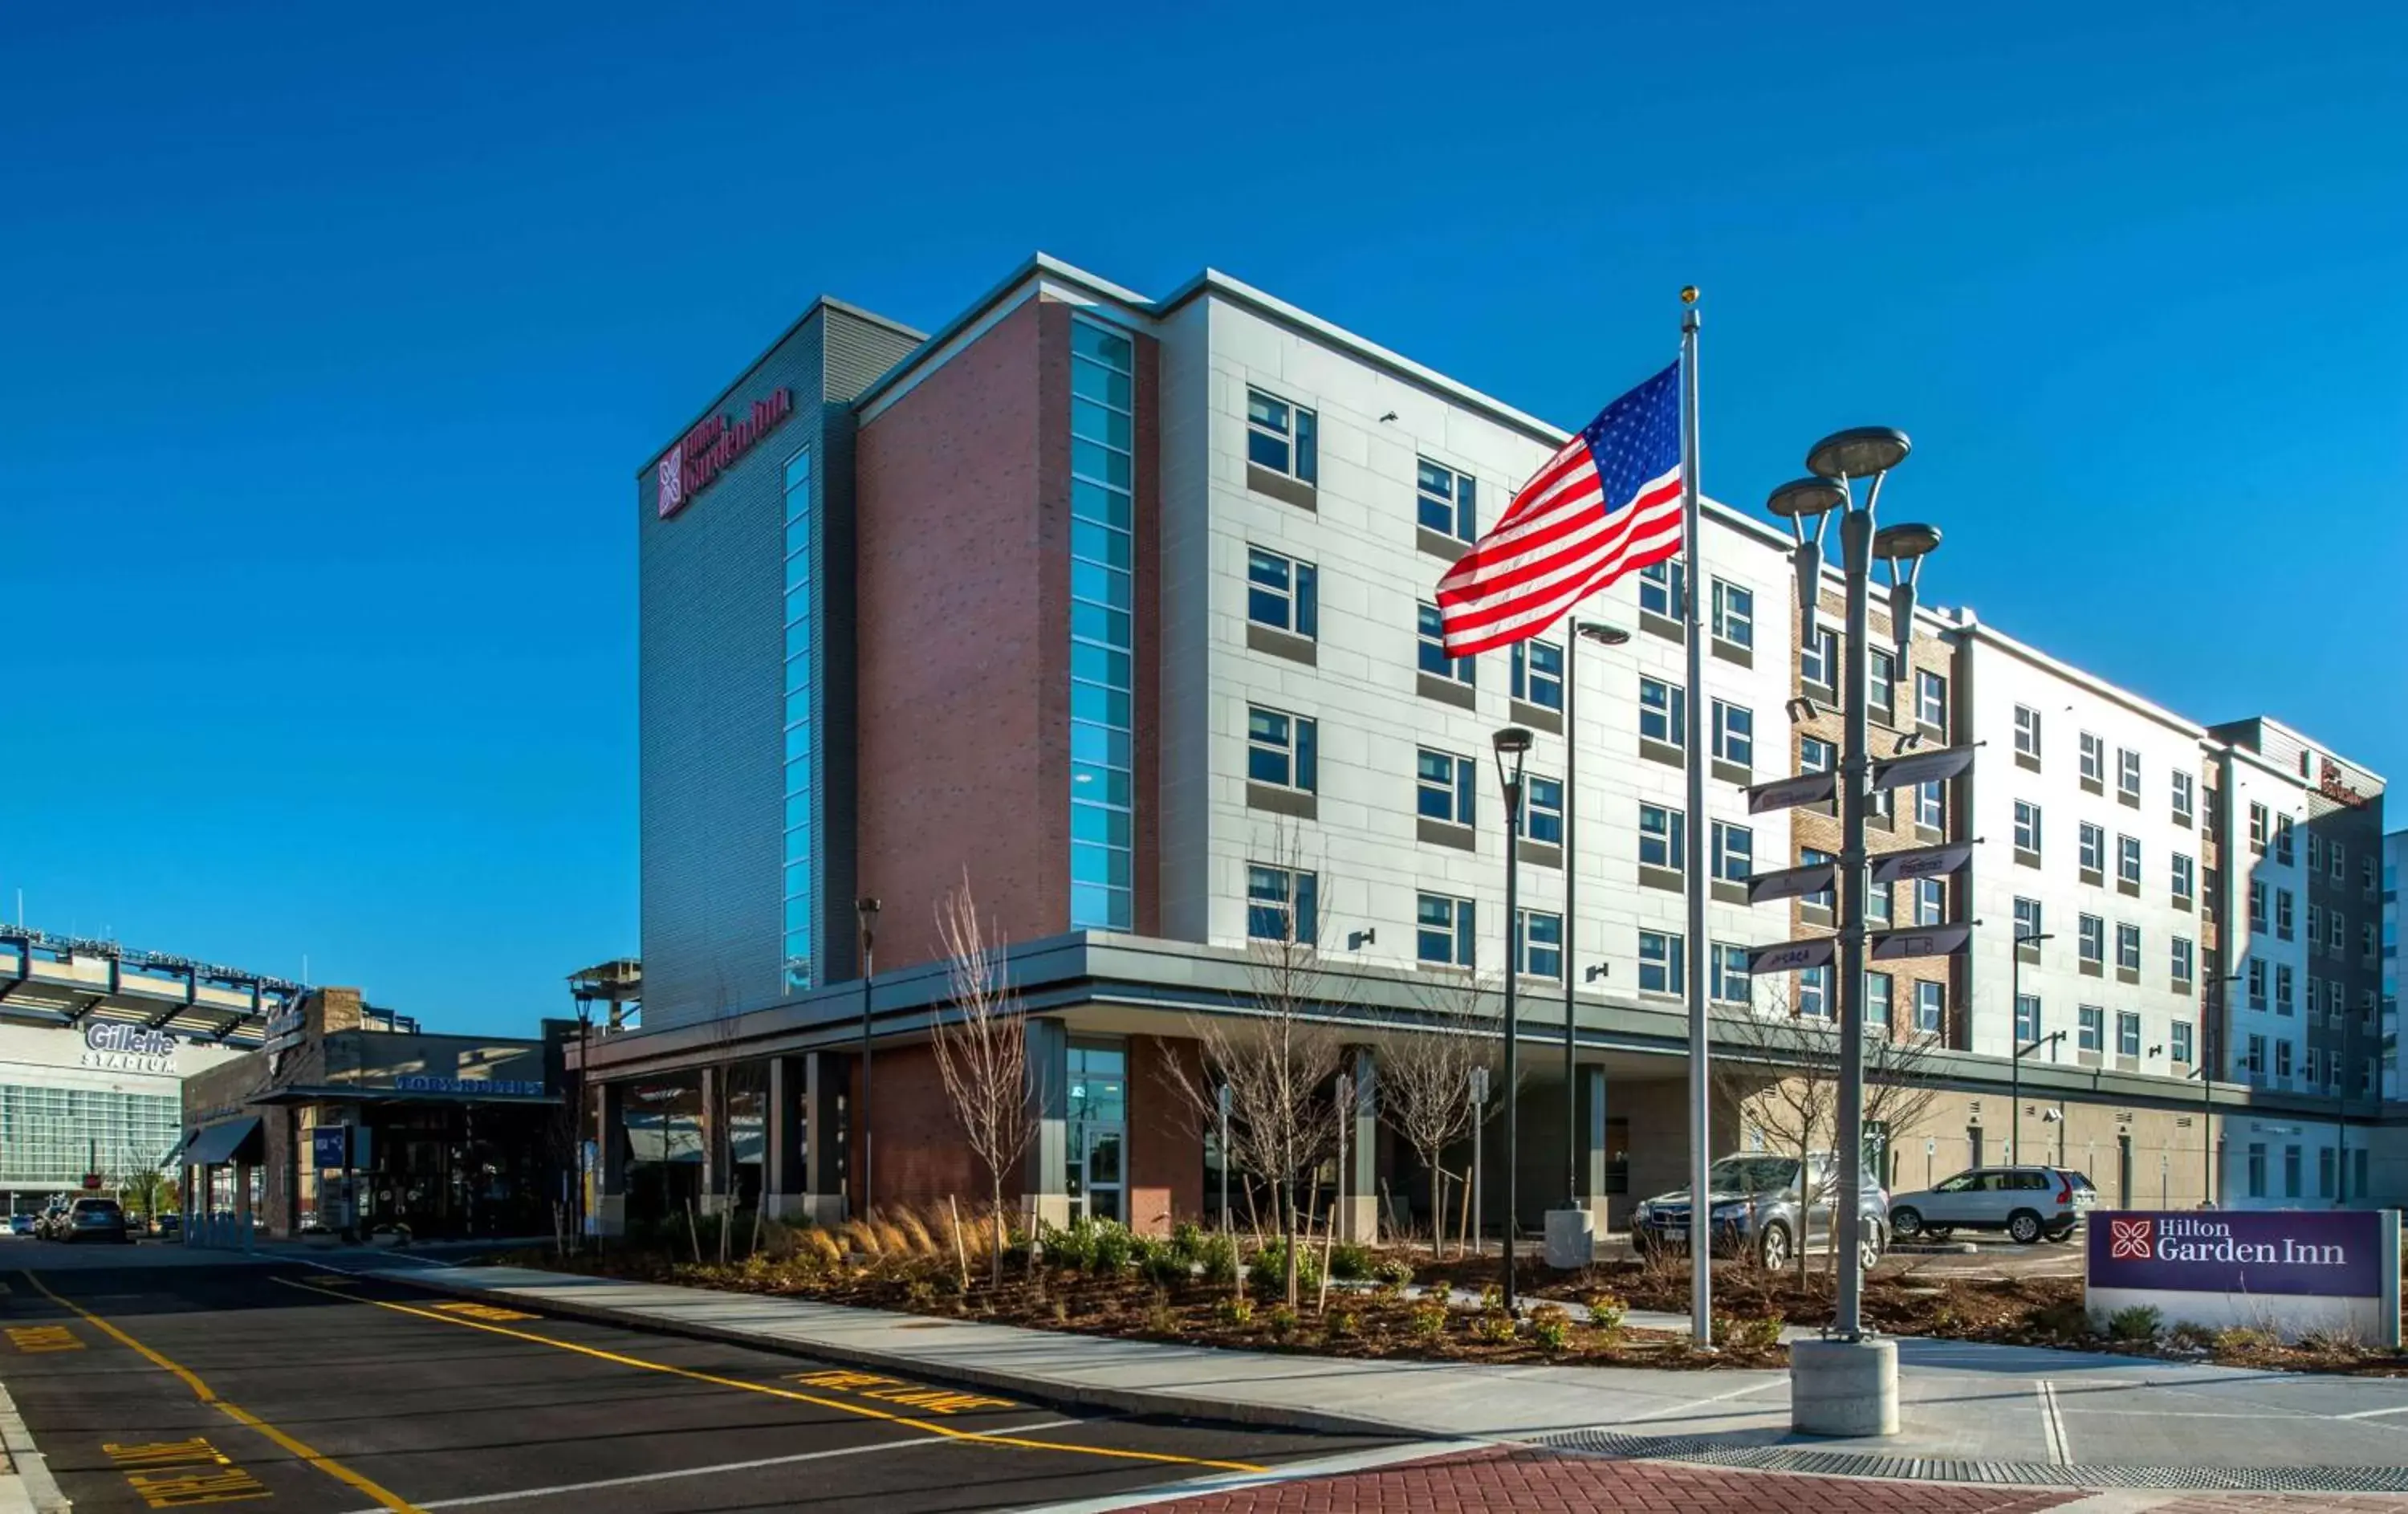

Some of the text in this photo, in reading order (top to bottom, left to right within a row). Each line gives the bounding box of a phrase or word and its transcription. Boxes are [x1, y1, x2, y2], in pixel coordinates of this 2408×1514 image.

[87, 1023, 174, 1056] Gillette
[82, 1053, 177, 1072] STADIUM
[2158, 1219, 2231, 1237] Hilton
[2157, 1237, 2347, 1264] Garden Inn
